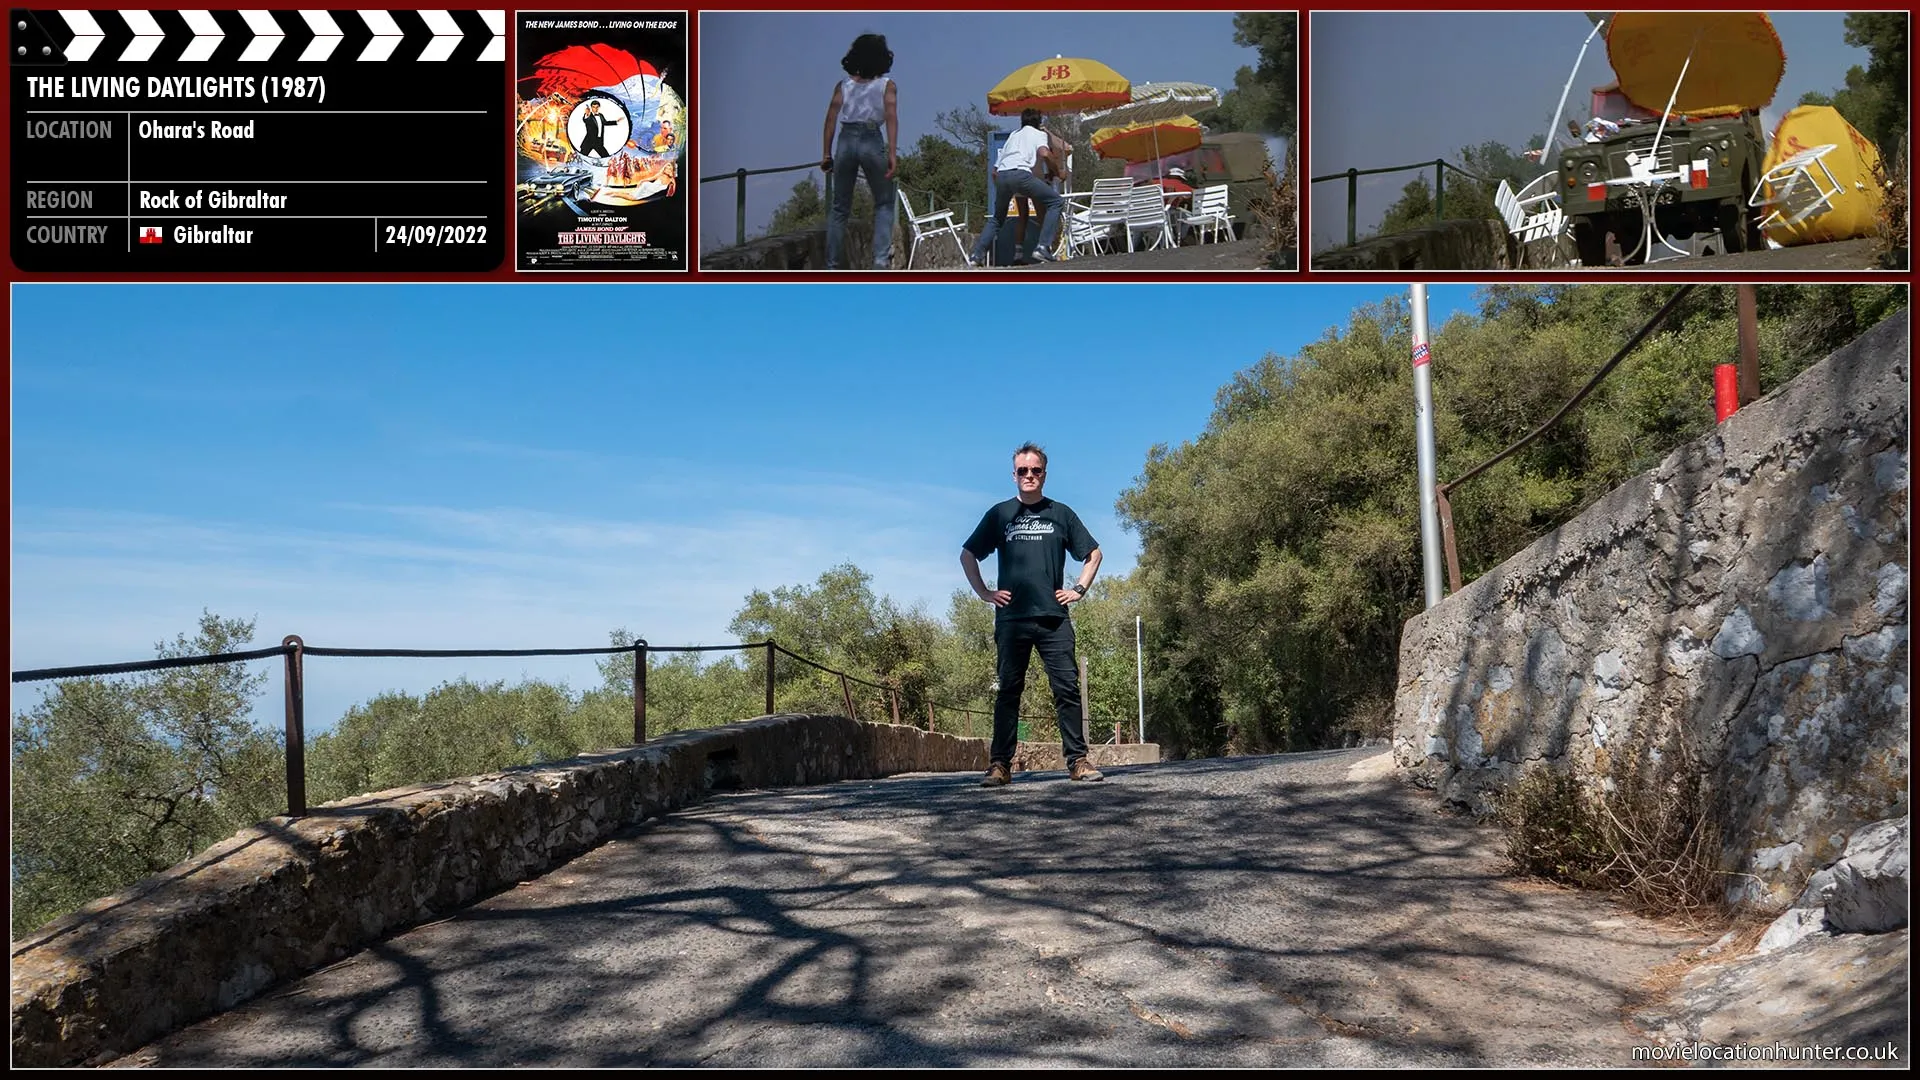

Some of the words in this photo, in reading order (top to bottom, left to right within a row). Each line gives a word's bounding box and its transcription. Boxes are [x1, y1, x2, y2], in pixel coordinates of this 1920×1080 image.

[525, 21, 537, 29] THE
[538, 21, 554, 29] NEW
[555, 21, 577, 29] JAMES
[609, 21, 632, 29] LIVING
[633, 21, 645, 29] ON
[645, 21, 658, 29] THE
[658, 21, 677, 29] EDGE
[1041, 64, 1071, 81] J&B
[558, 233, 574, 244] THE
[575, 233, 602, 244] LIVING
[603, 233, 646, 244] DAYLIGHTS
[1029, 520, 1053, 530] Bond
